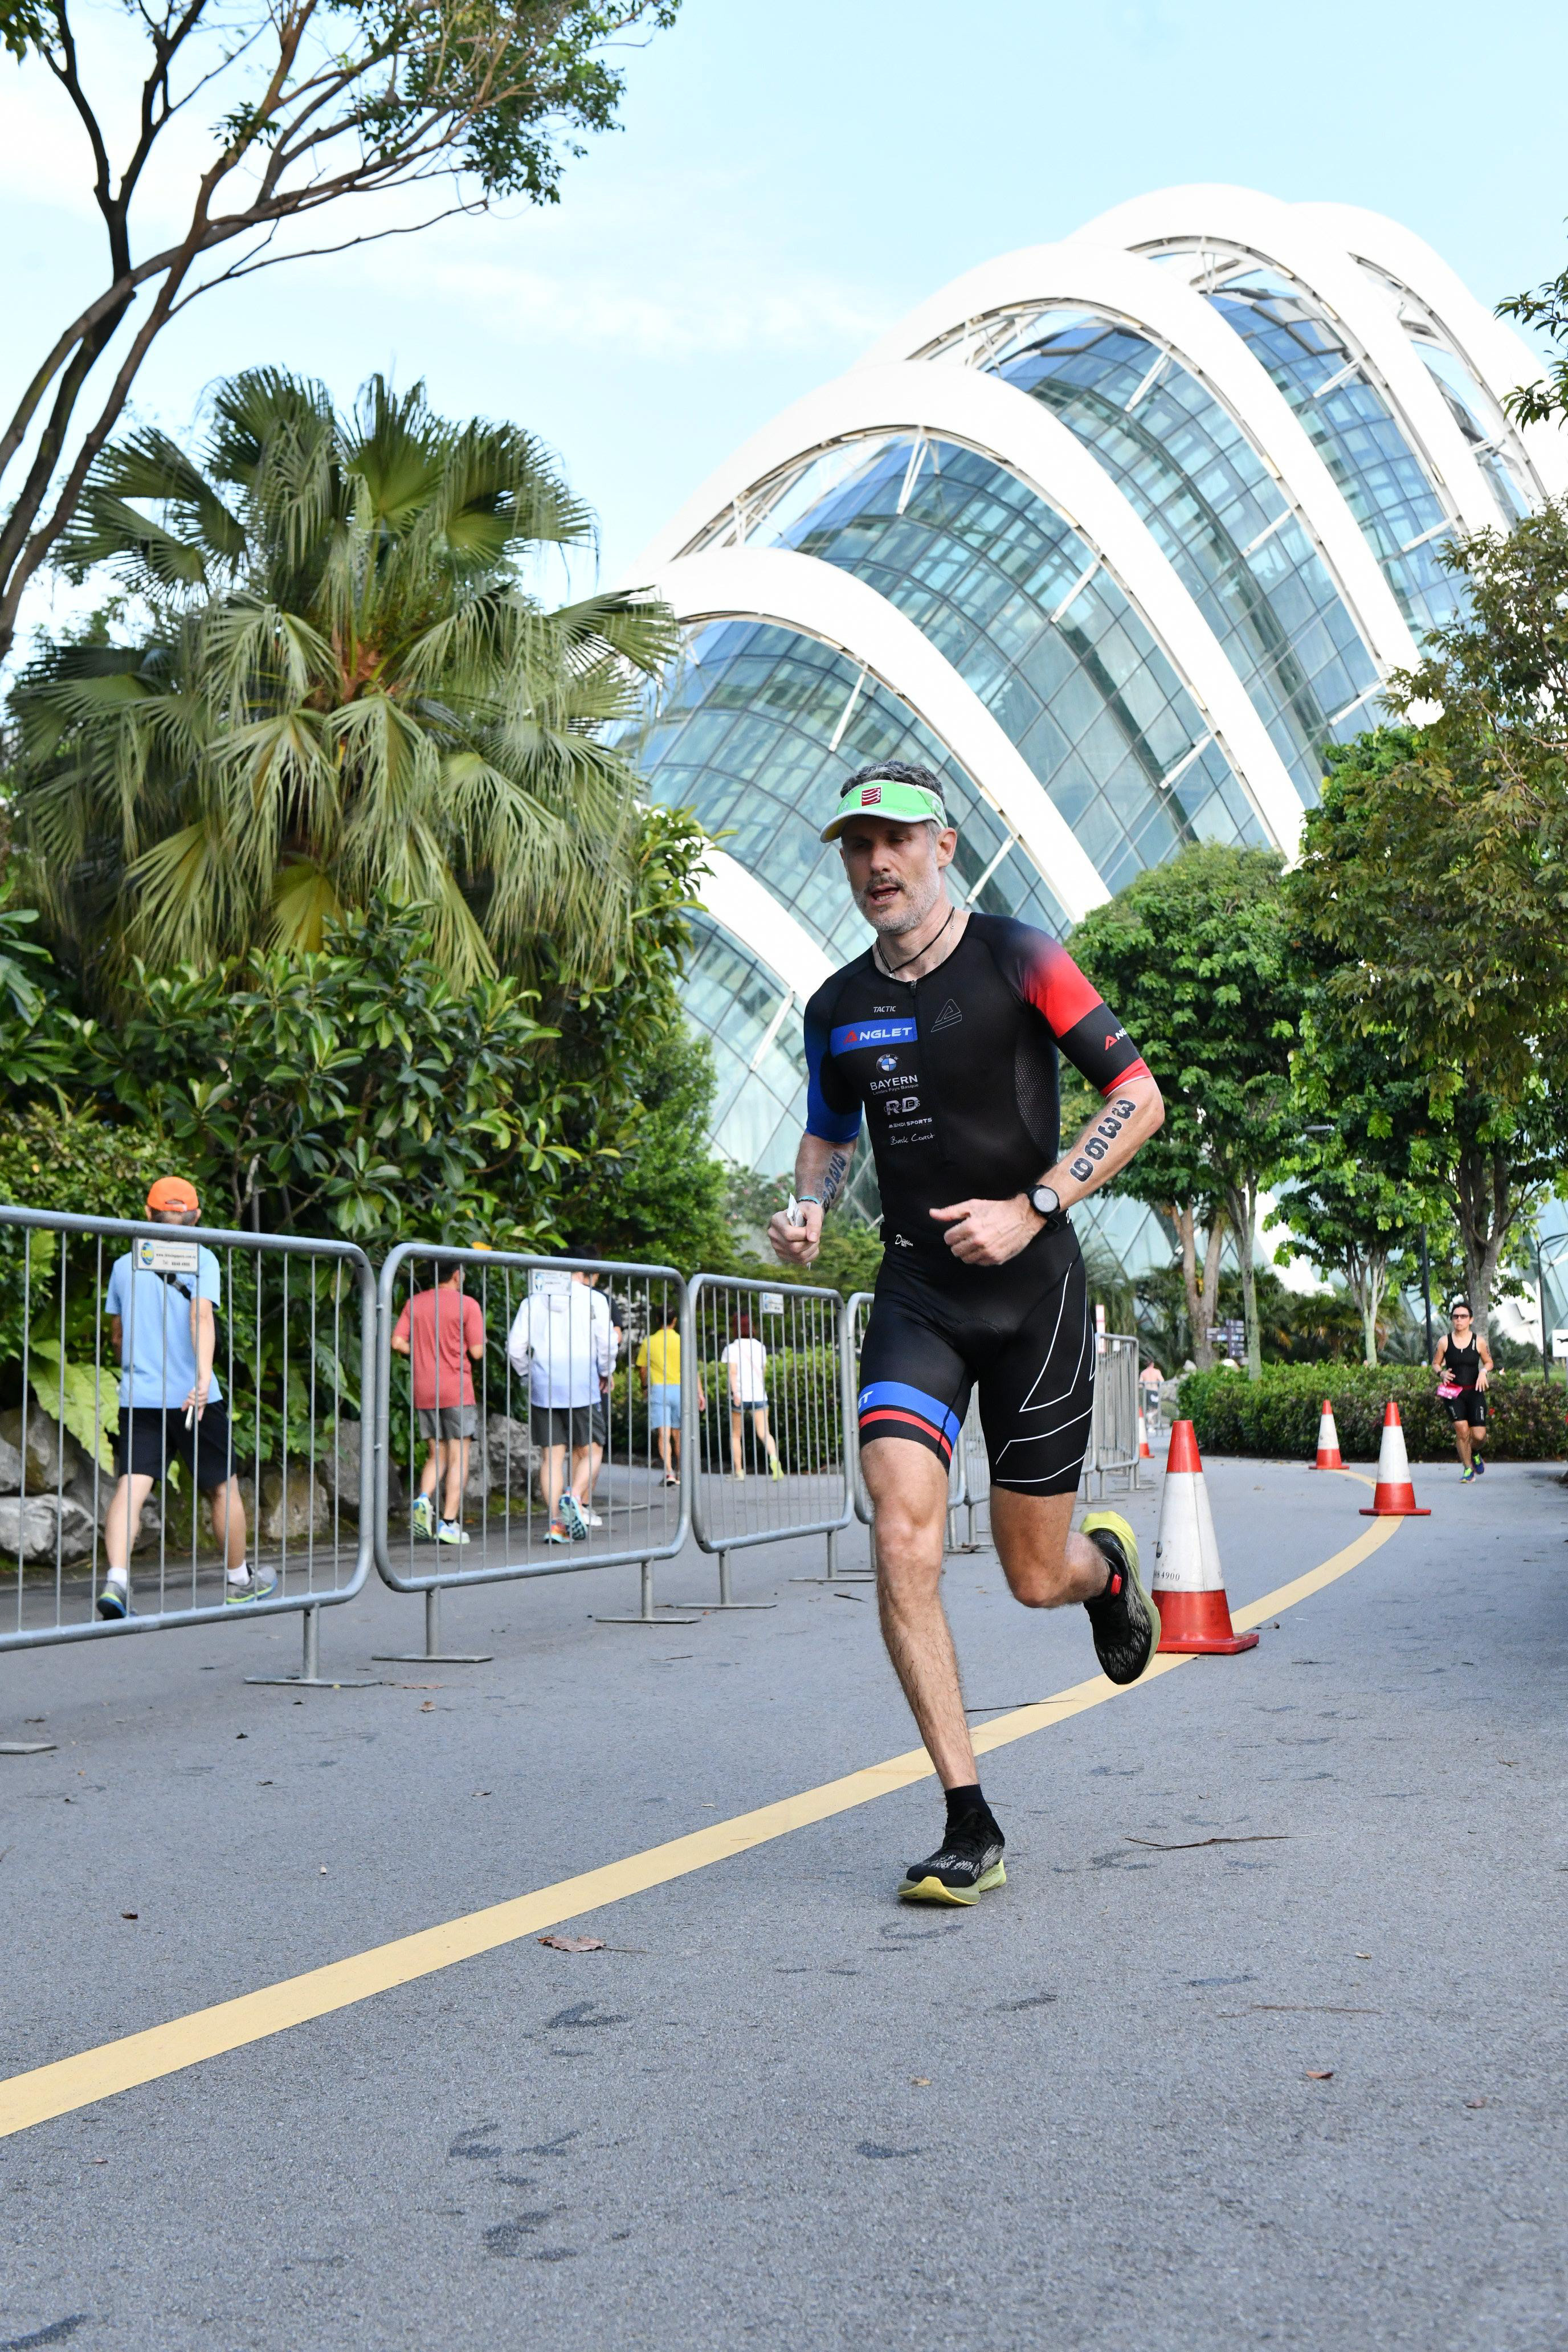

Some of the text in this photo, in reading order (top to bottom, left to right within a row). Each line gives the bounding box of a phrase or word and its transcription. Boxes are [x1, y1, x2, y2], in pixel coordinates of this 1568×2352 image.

[879, 1054, 899, 1063] BMW
[869, 1075, 918, 1091] BAYERN
[906, 1117, 933, 1125] SPORTS
[911, 1132, 935, 1142] Coast
[1161, 1571, 1180, 1581] 4900
